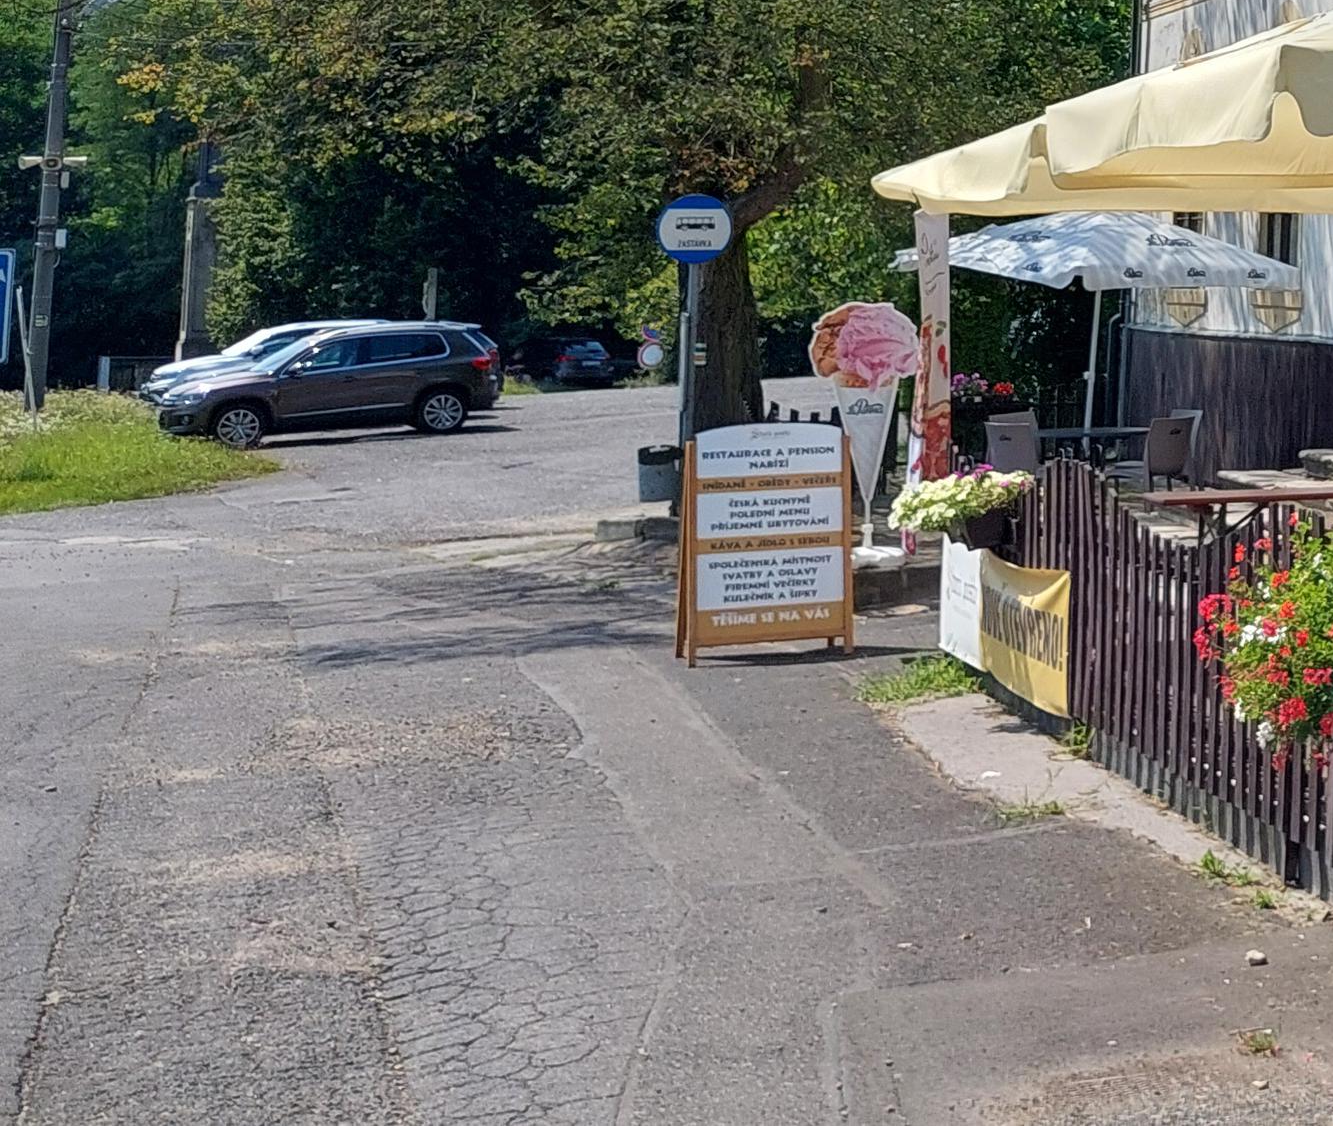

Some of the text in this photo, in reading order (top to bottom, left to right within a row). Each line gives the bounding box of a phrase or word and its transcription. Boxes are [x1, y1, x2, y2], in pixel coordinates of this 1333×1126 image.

[702, 446, 835, 460] RESTAURACE A PENSION
[778, 507, 810, 516] MENU
[767, 569, 776, 578] A
[778, 591, 787, 600] A
